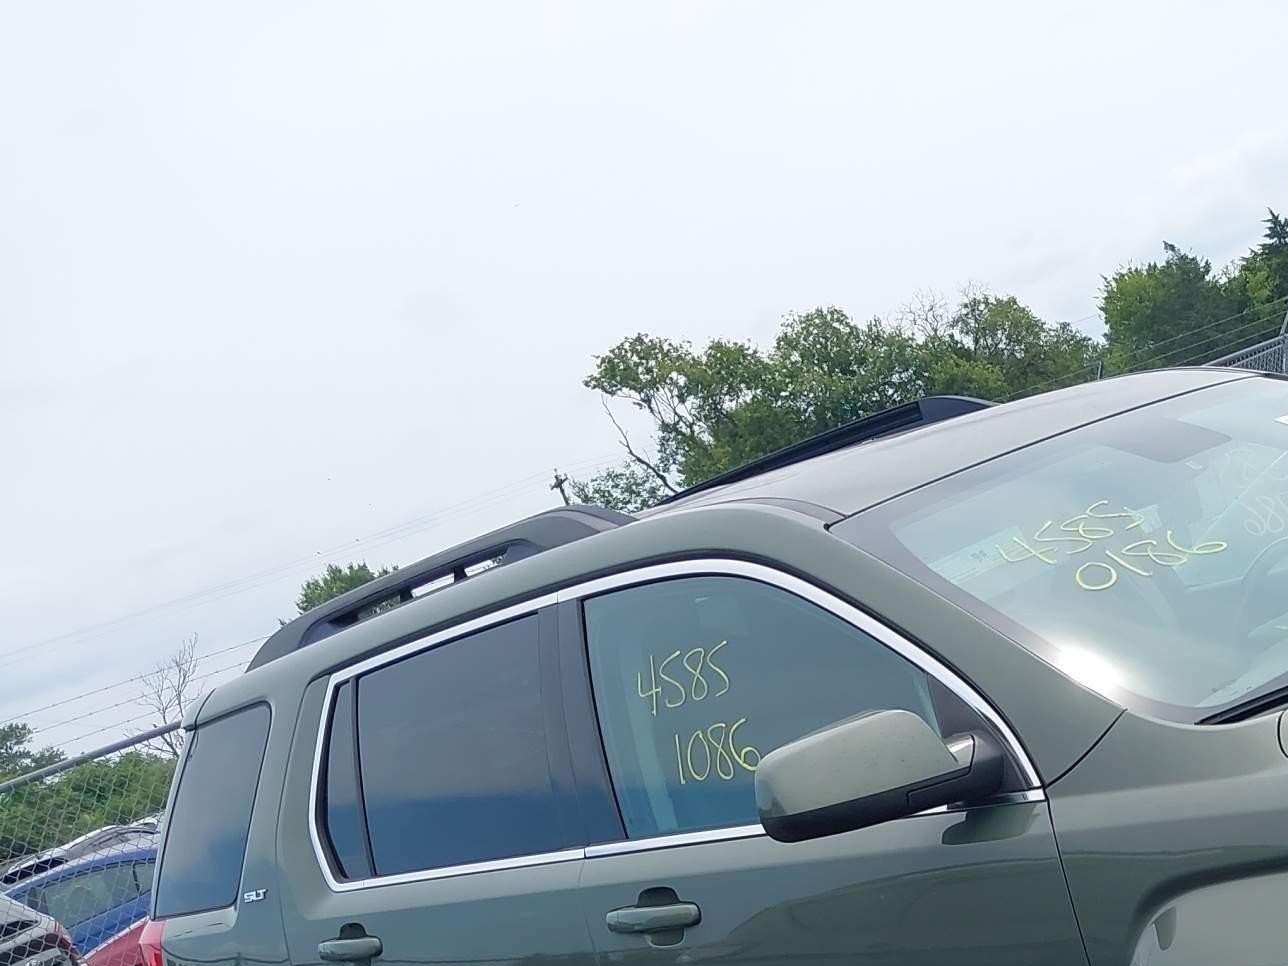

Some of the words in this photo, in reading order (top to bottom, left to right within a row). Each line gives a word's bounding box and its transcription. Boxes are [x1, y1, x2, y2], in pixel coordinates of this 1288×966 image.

[995, 500, 1145, 565] 4585
[1076, 530, 1228, 590] 0186
[637, 640, 730, 716] 4585
[674, 717, 762, 785] 1086
[243, 888, 267, 904] SLT
